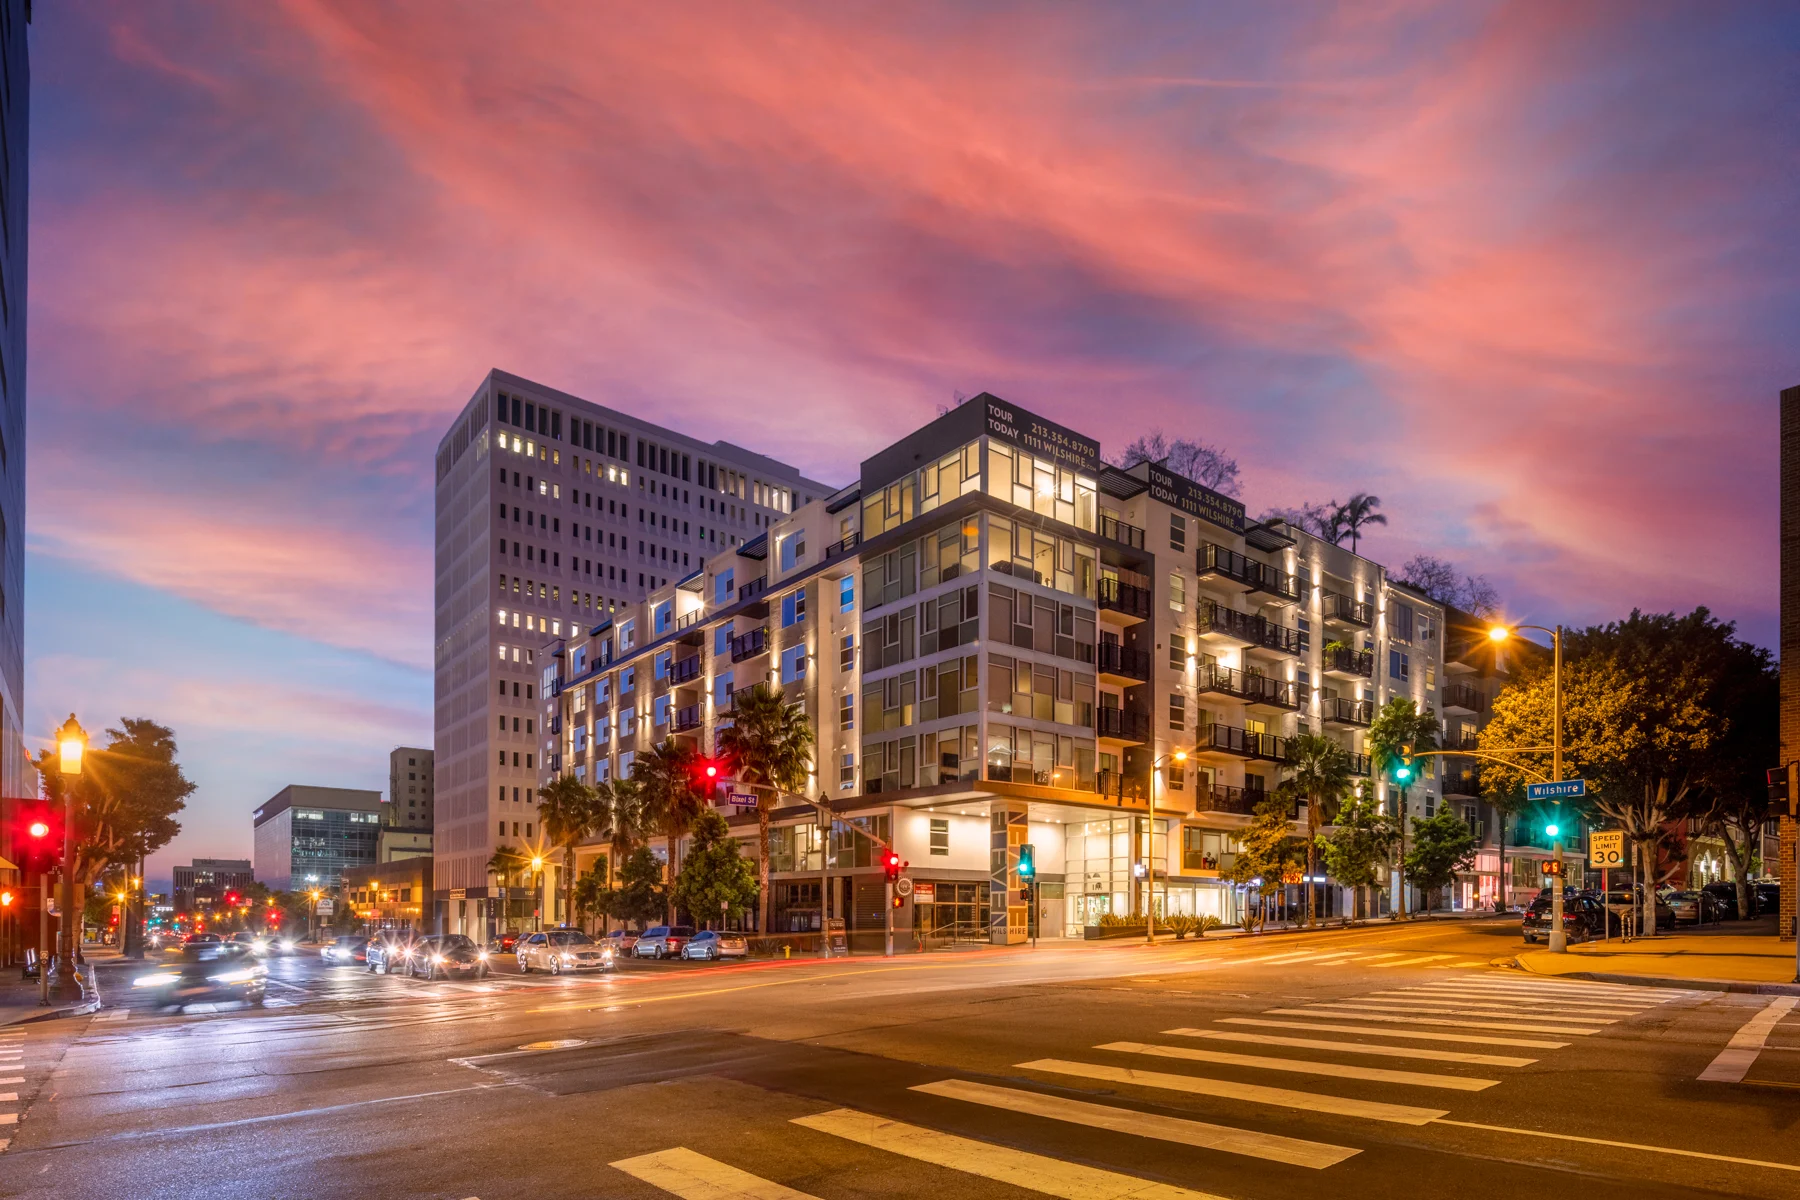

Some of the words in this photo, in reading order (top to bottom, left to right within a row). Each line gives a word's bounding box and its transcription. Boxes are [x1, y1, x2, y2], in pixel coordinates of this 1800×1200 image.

[988, 404, 1013, 423] TOUR
[988, 418, 1019, 439] TODAY
[1024, 434, 1041, 450] 1111
[1031, 422, 1095, 458] 213.354.8790
[1150, 470, 1173, 488] TOUR
[1151, 485, 1178, 504] TODAY
[1188, 487, 1243, 518] 213.354.8790
[1181, 497, 1197, 513] 1111
[1533, 784, 1579, 796] Wilshire
[731, 795, 747, 803] Bixel
[747, 796, 755, 804] St
[1593, 834, 1621, 842] SPEED
[1595, 842, 1617, 850] LIMIT
[1594, 850, 1619, 864] 30
